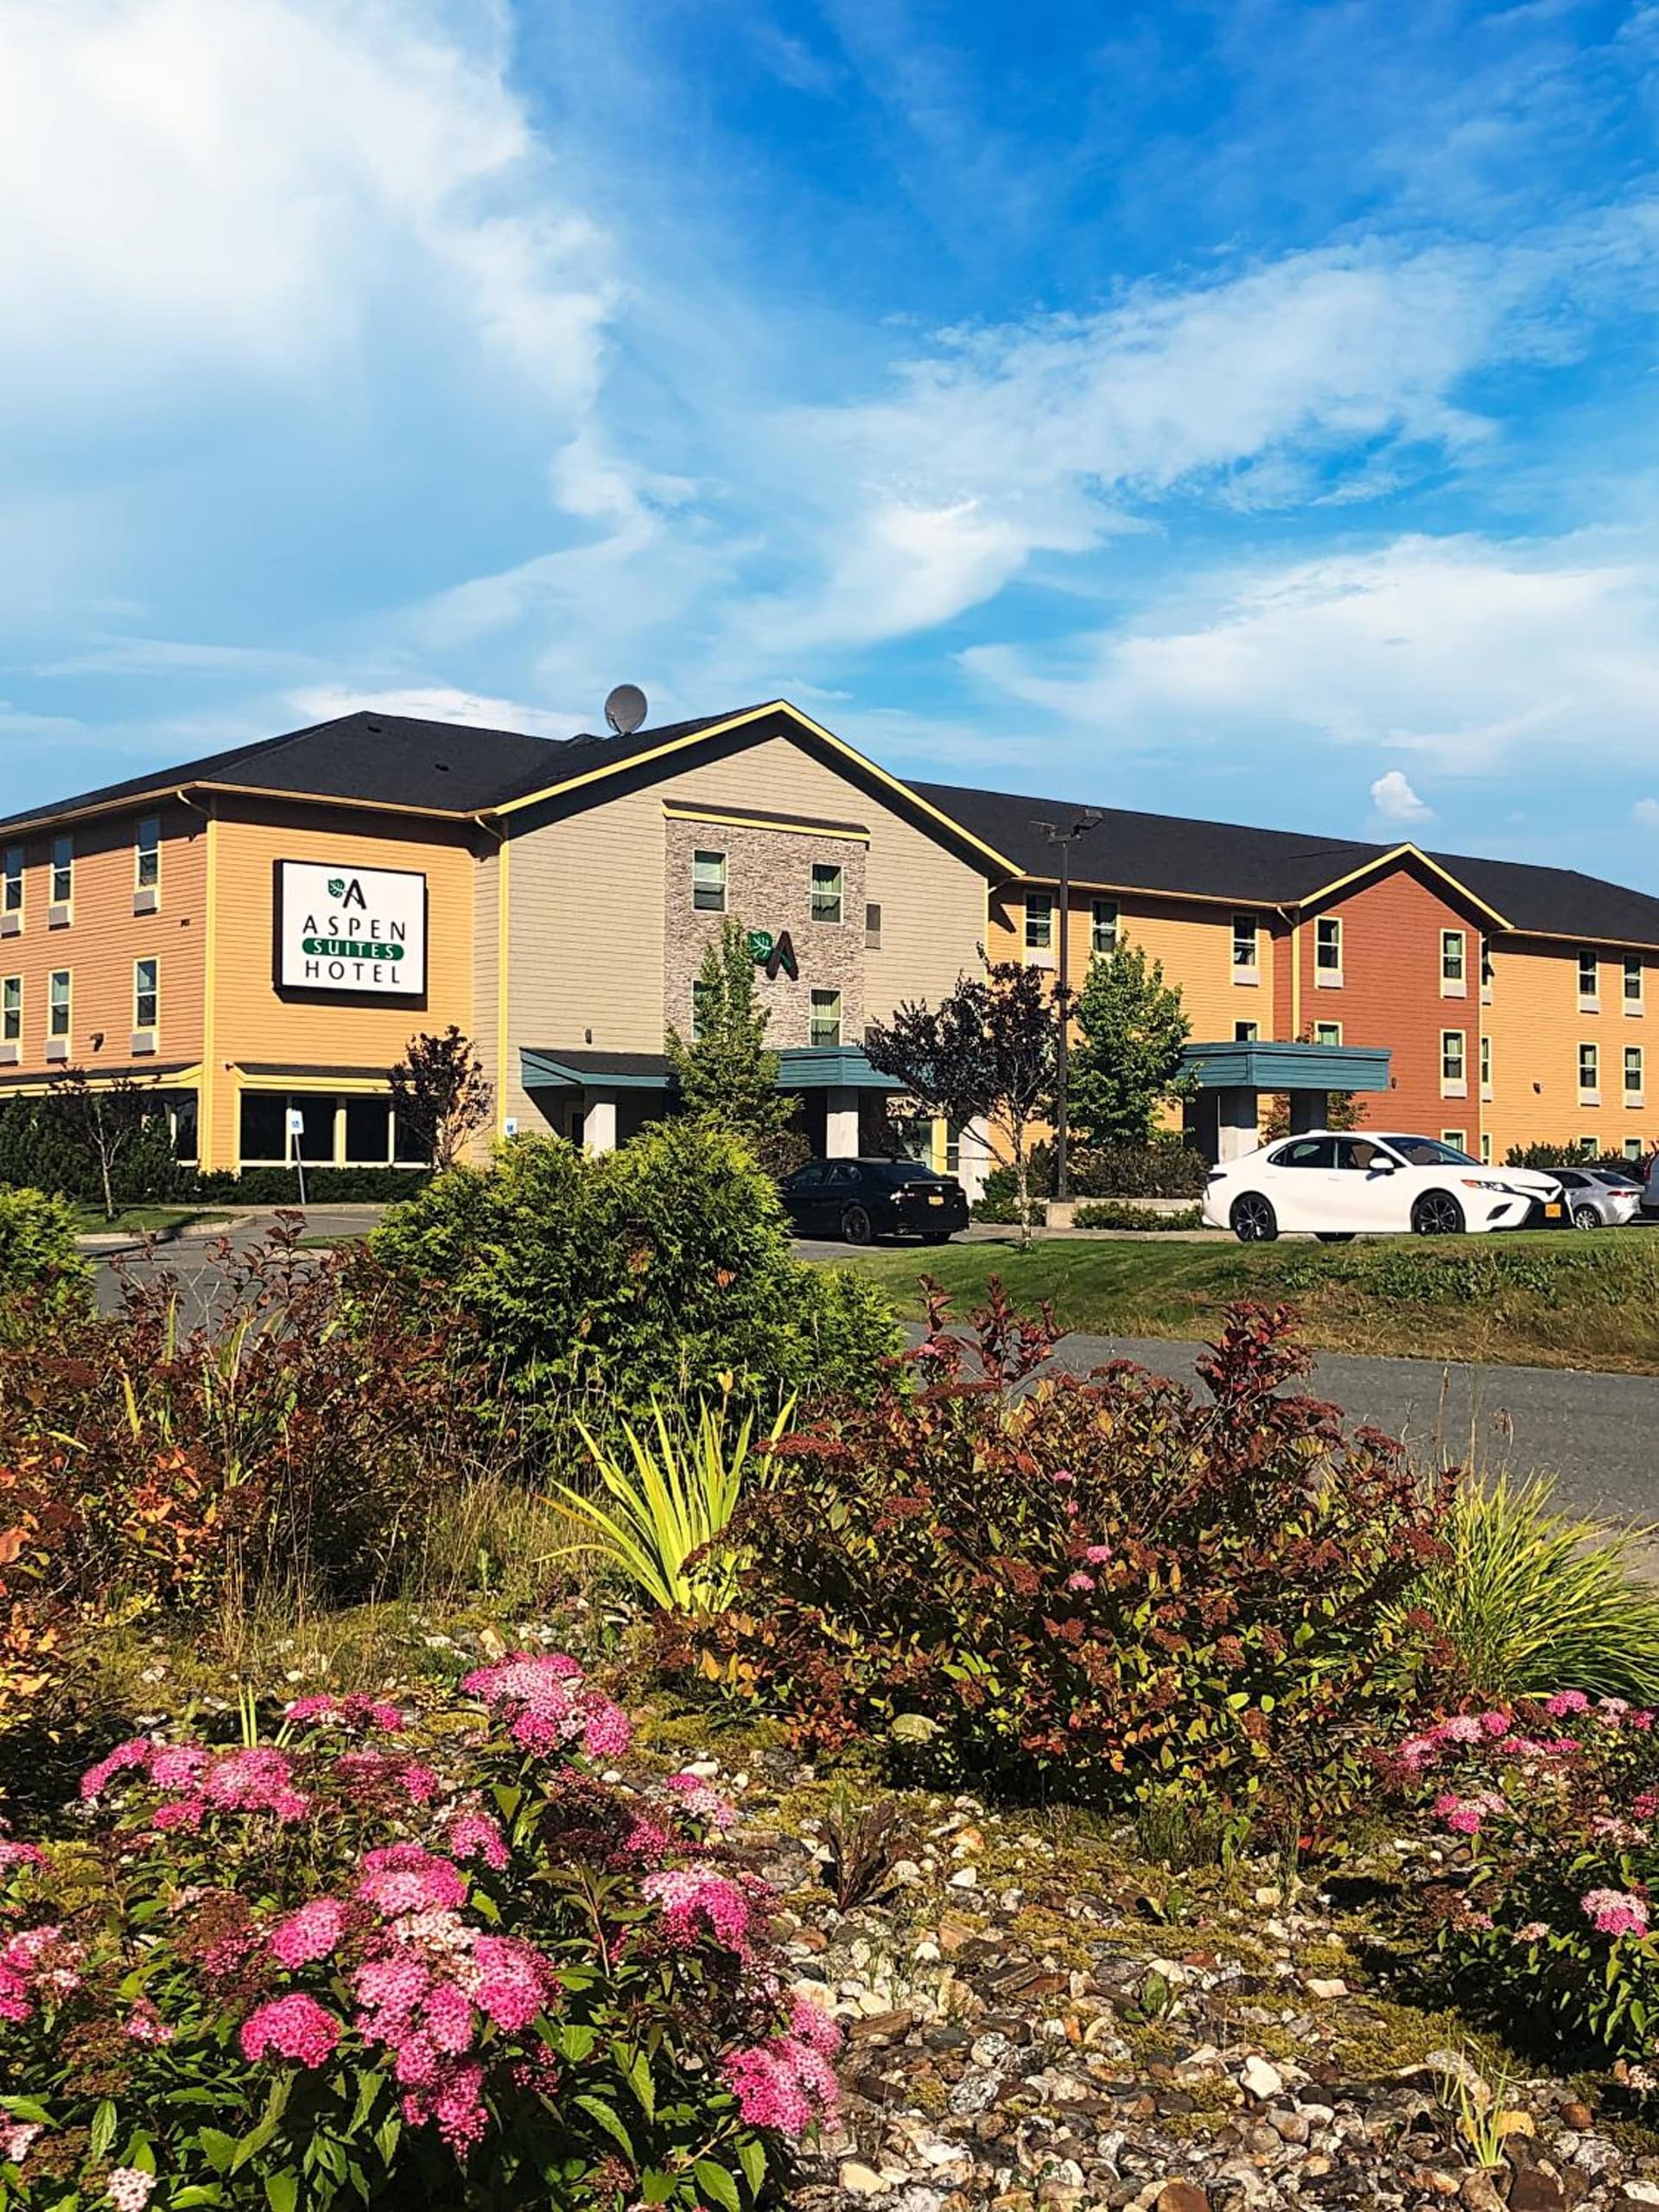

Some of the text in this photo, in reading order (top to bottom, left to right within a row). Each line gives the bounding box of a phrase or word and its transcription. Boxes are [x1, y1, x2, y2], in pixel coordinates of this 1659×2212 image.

[342, 879, 366, 910] A
[302, 914, 405, 941] ASPEN
[313, 939, 394, 959] SUITES
[305, 959, 400, 984] HOTEL
